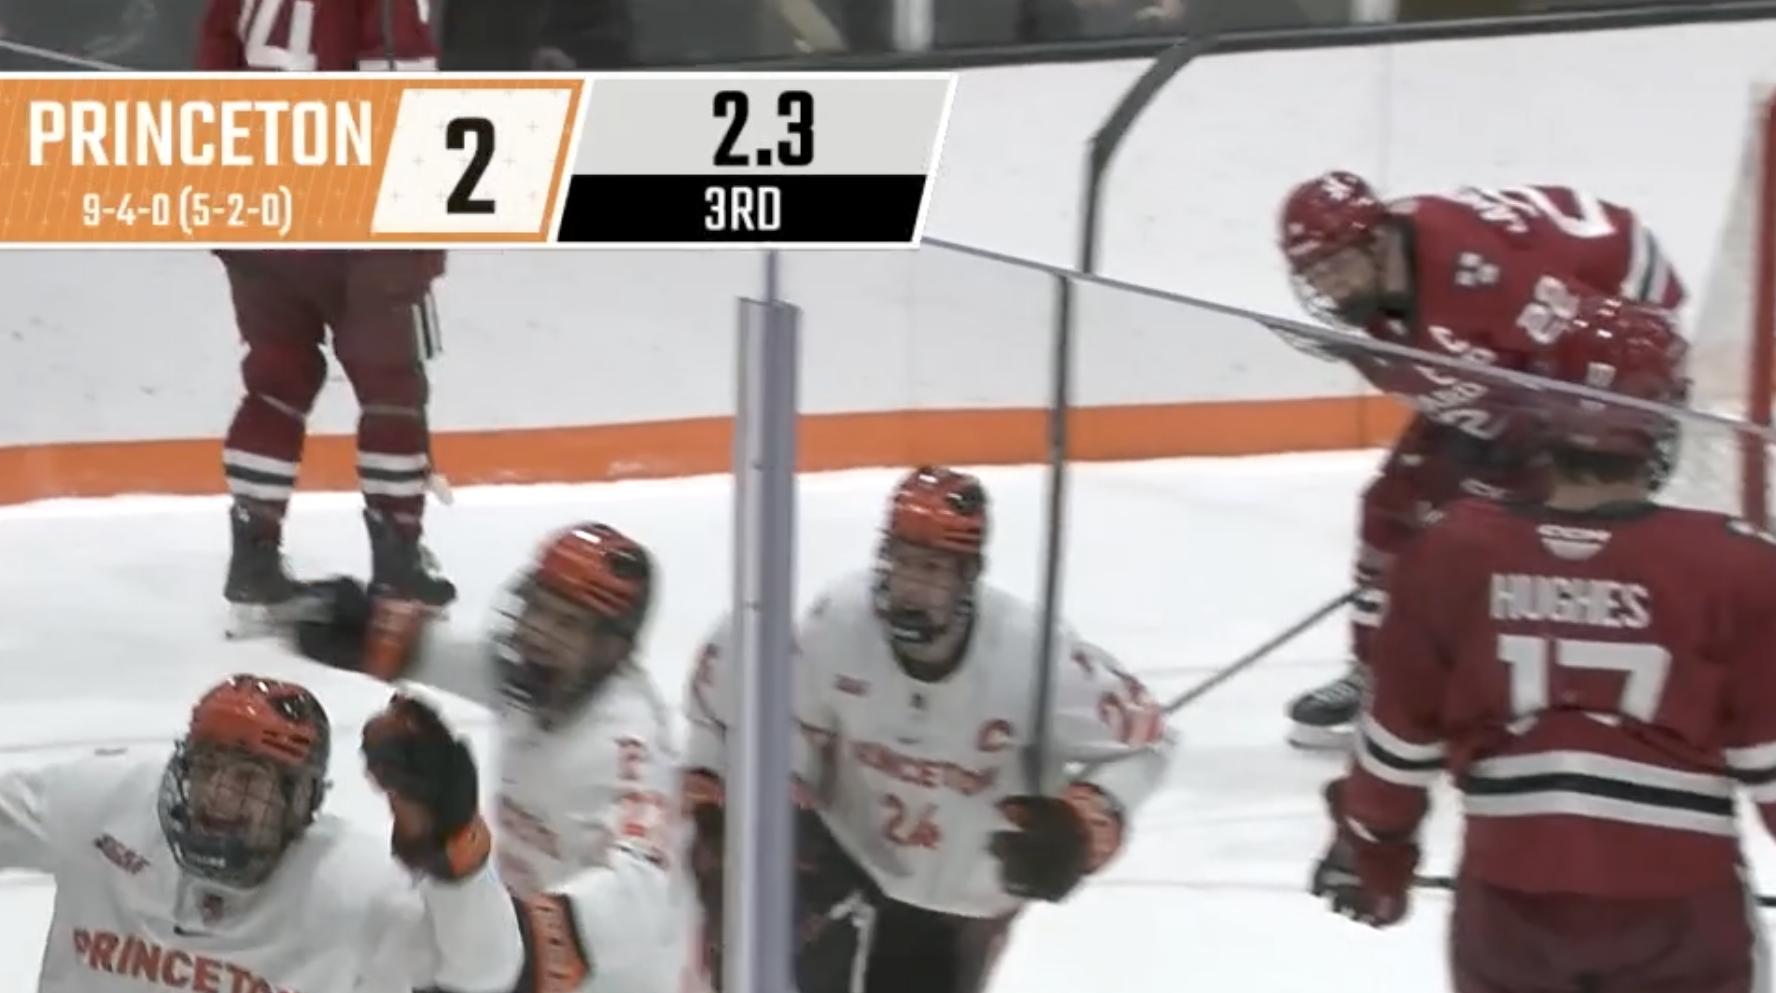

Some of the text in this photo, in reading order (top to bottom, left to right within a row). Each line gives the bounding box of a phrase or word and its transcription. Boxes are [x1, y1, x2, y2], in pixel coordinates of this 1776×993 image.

[237, 0, 317, 71] 4
[1489, 573, 1651, 629] HUGHES
[1497, 633, 1673, 734] 17
